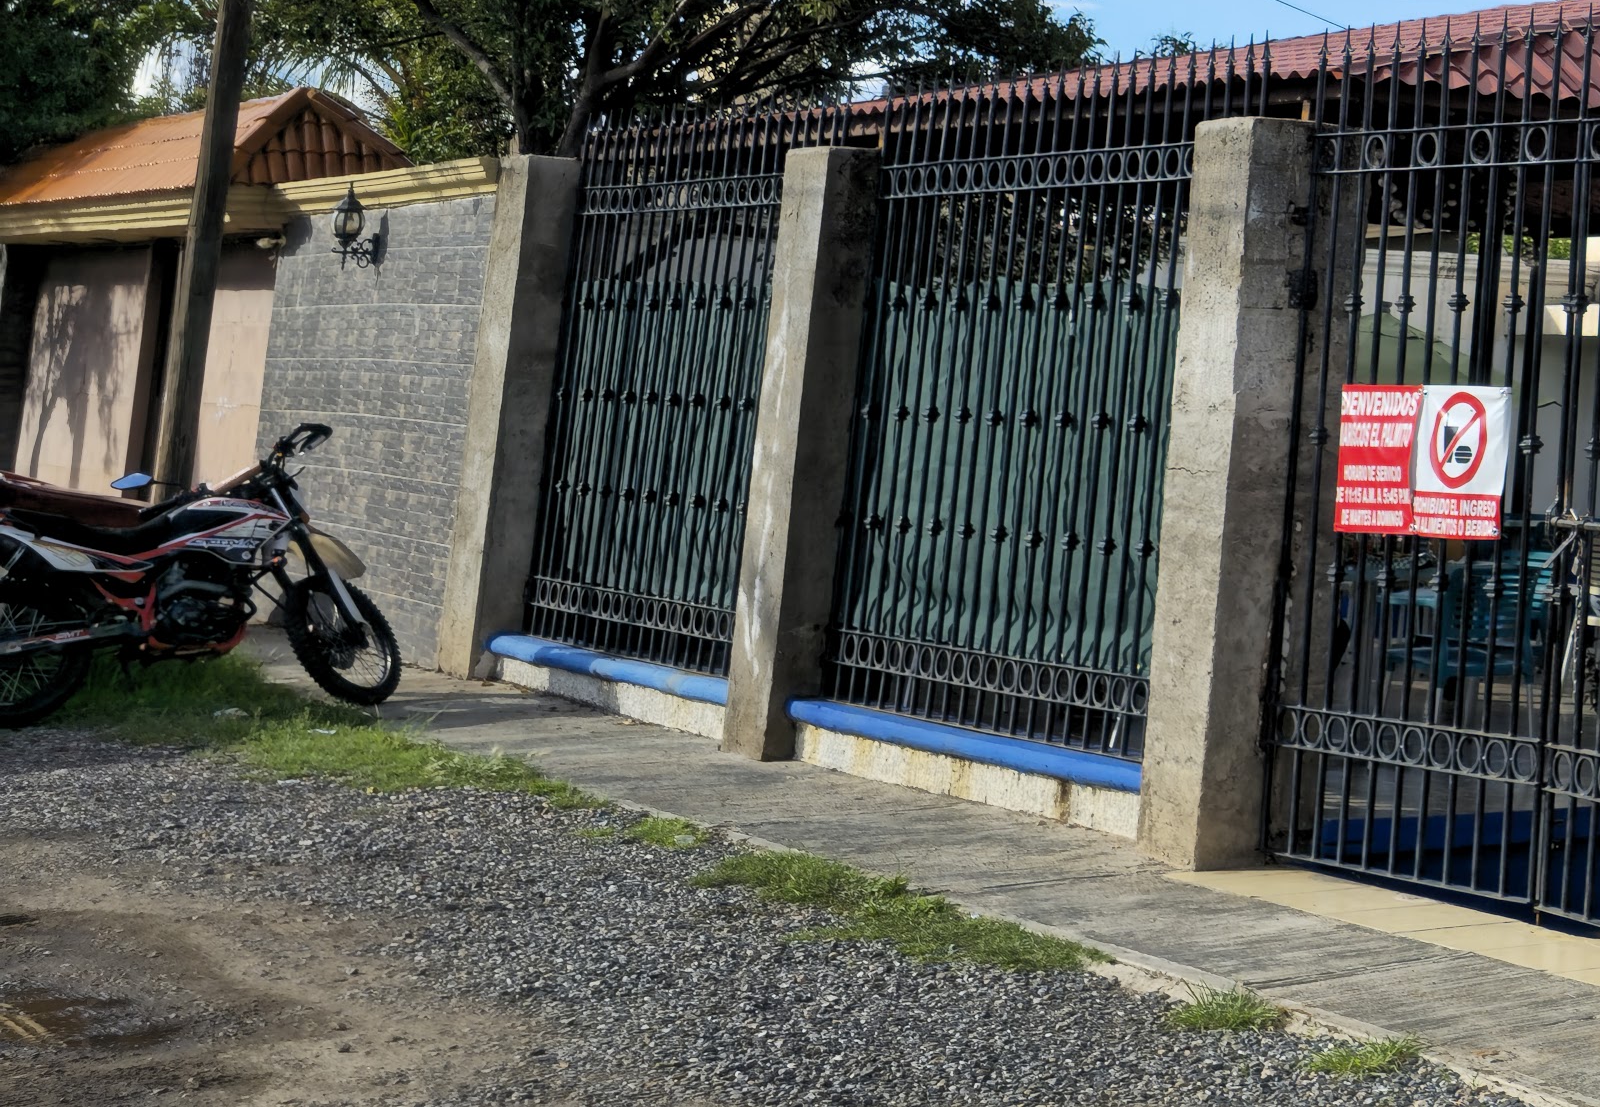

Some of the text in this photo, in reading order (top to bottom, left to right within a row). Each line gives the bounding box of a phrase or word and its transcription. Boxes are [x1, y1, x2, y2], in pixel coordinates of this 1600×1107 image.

[1370, 423, 1380, 447] EL
[1380, 423, 1413, 448] PALMITO
[1367, 465, 1376, 481] DE
[1376, 465, 1402, 482] SERVICIO
[1377, 488, 1383, 504] A
[1450, 499, 1458, 516] EL
[1459, 500, 1496, 517] INGRESO
[1341, 509, 1403, 526] DE MARTES A DOMINGO
[1420, 517, 1457, 535] ALIMENTOS
[1458, 519, 1464, 536] O
